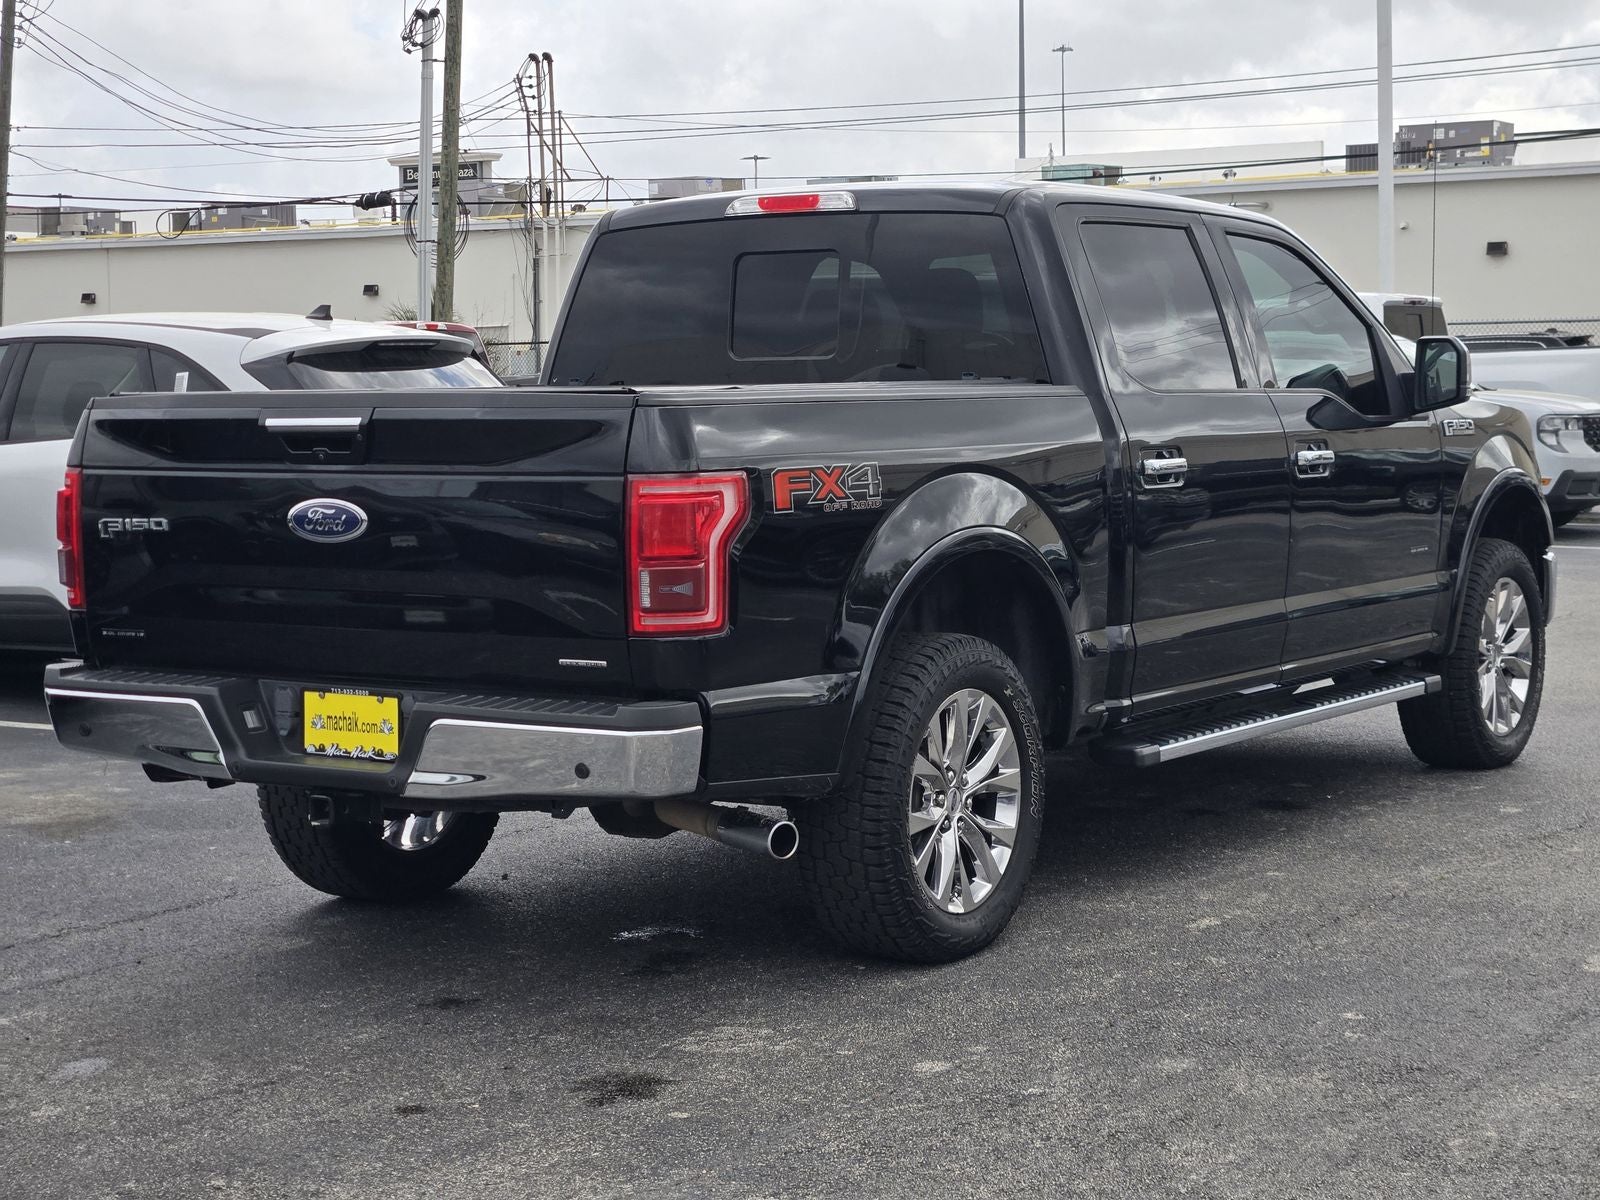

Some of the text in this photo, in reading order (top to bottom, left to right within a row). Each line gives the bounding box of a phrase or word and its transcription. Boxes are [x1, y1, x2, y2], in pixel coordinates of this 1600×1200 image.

[771, 462, 882, 514] FX4
[824, 499, 882, 512] OFF ROAD
[304, 507, 346, 531] Ford
[326, 711, 379, 733] machaik.com
[325, 743, 349, 757] Mac
[350, 745, 375, 759] Haik
[1012, 698, 1040, 818] SCORPION
